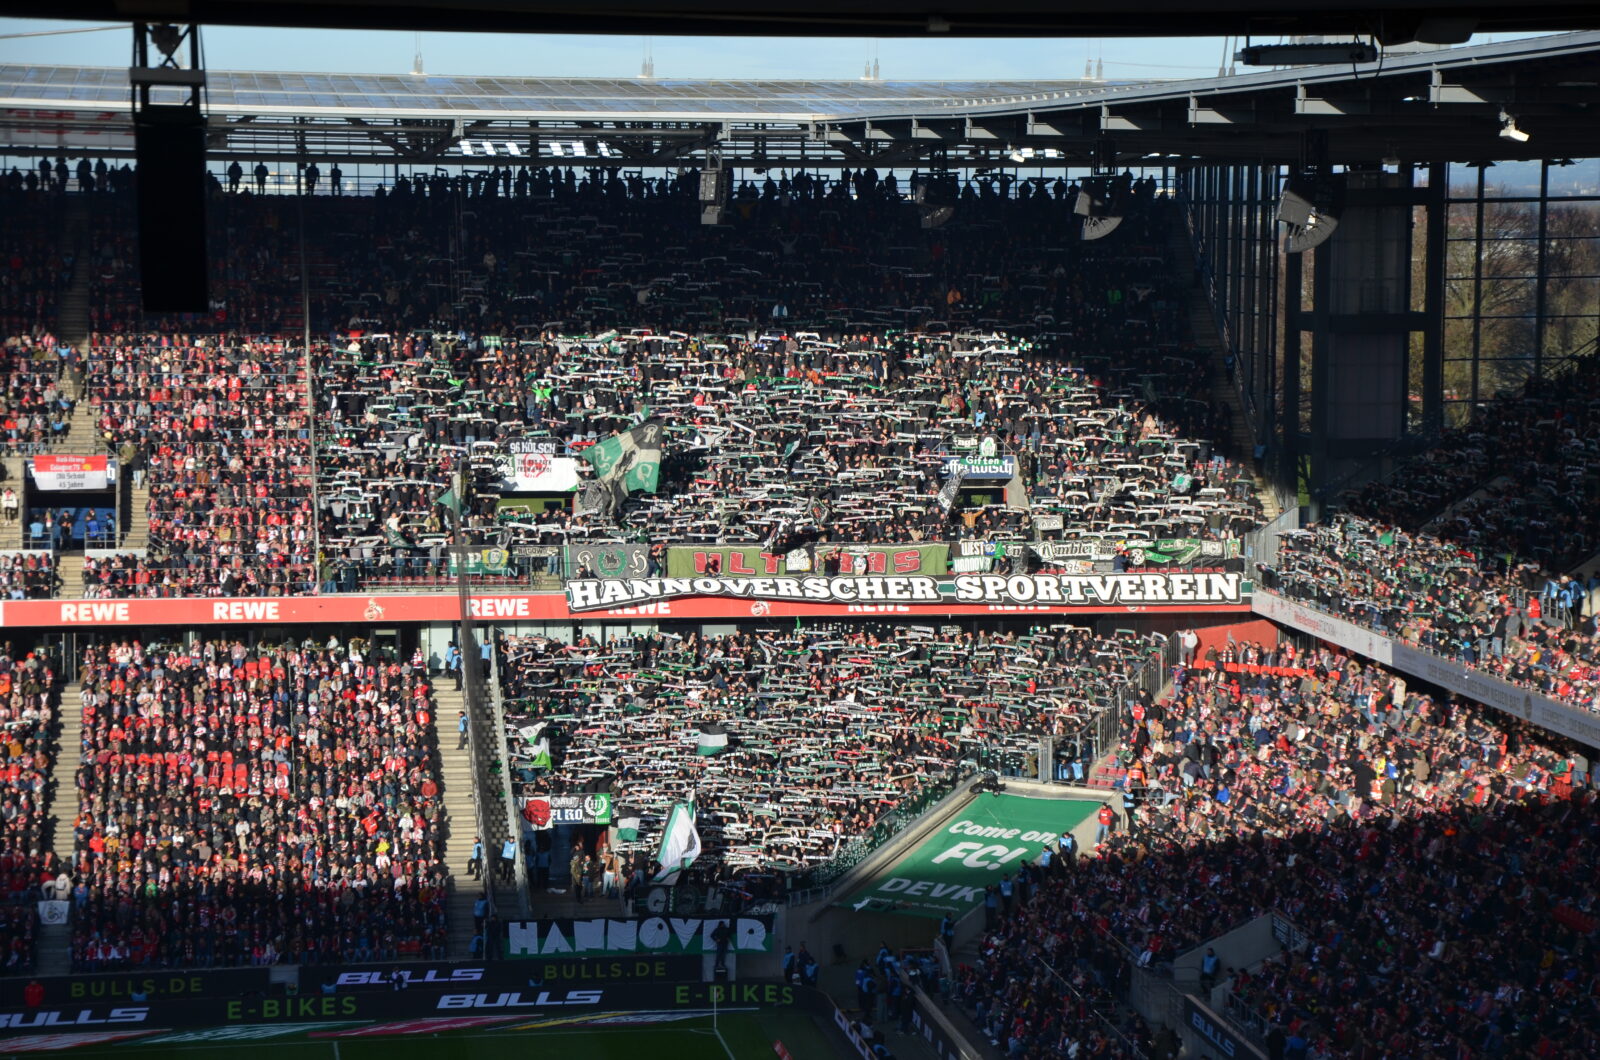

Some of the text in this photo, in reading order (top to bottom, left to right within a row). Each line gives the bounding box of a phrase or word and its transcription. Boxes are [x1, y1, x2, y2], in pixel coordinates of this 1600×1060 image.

[509, 442, 520, 454] 96
[961, 541, 984, 556] WEST
[568, 573, 1240, 609] HANNOVERSCHER SPORTVEREIN
[61, 602, 131, 622] REWE
[213, 601, 280, 620] REWE
[468, 598, 530, 617] REWE
[948, 820, 1020, 841] Come
[931, 841, 1028, 871] FC!
[877, 877, 986, 902] DEVK
[544, 961, 667, 980] BULLS.DE
[71, 977, 203, 998] BULLS.DE
[675, 984, 794, 1005] E-BIKES
[227, 996, 357, 1020] E-BIKES
[437, 989, 603, 1010] BULLS
[1190, 1011, 1236, 1058] BULLS
